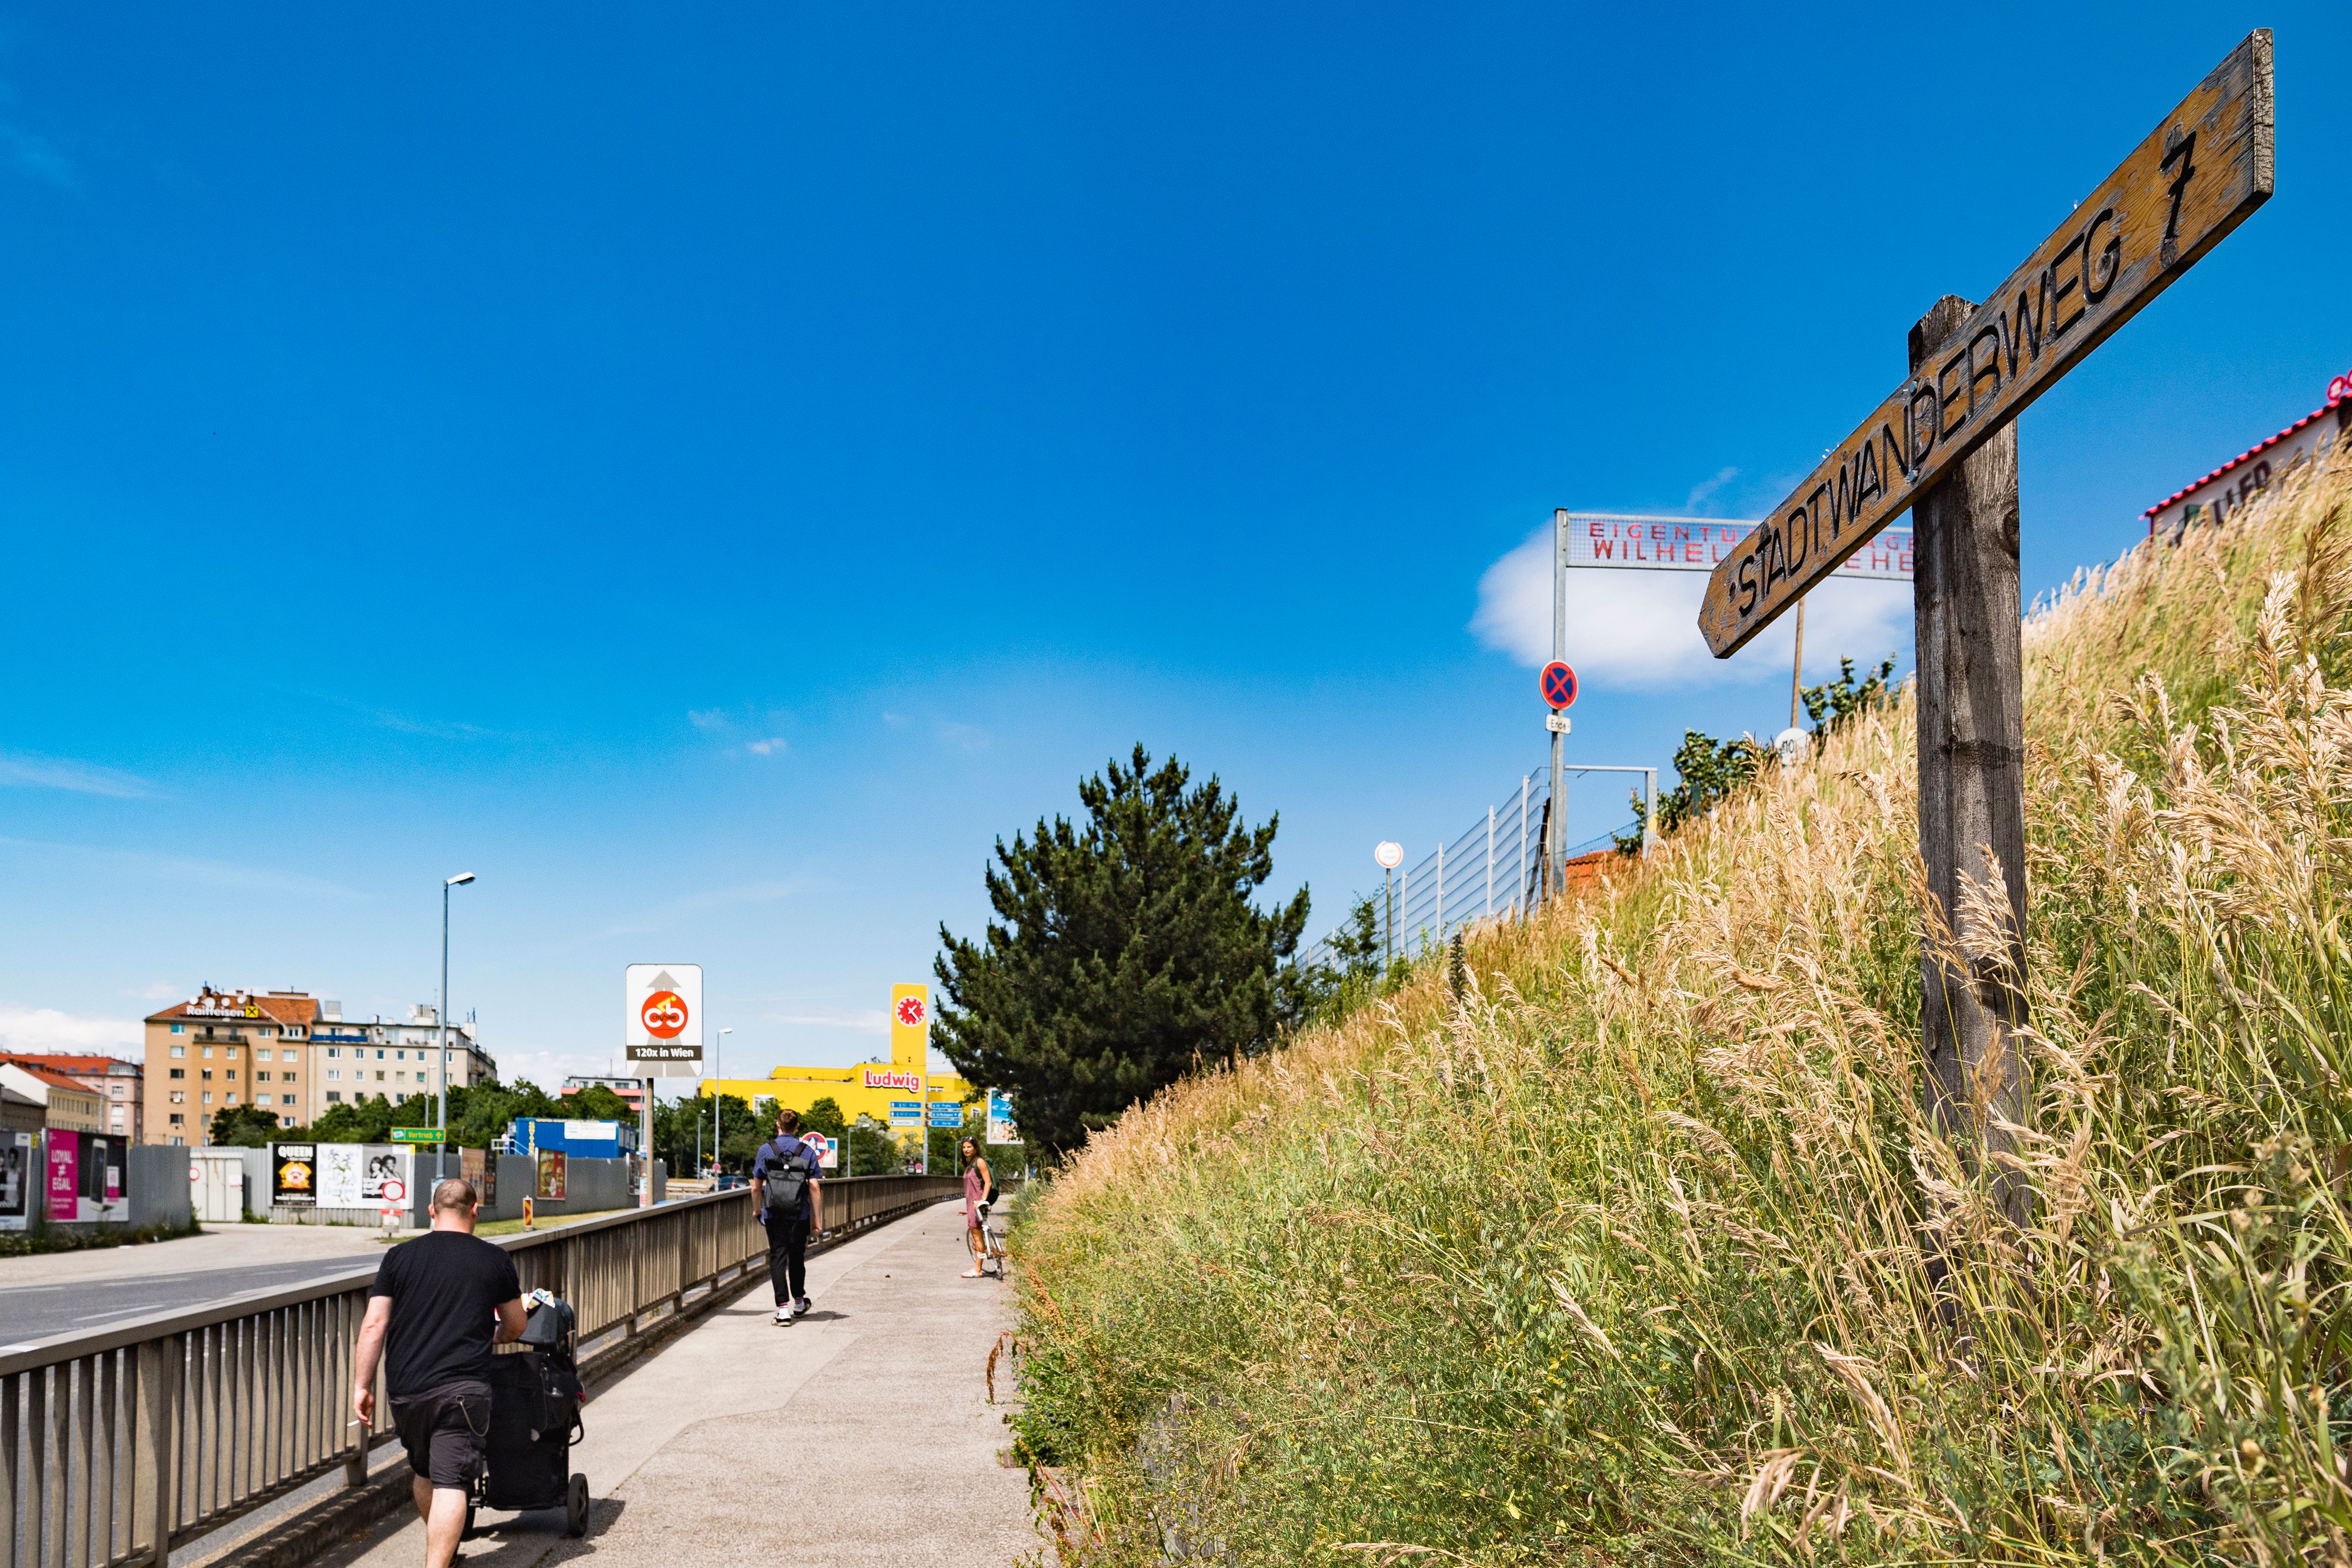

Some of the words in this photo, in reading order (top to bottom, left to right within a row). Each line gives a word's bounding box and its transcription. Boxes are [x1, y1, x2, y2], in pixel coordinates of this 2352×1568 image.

[1739, 208, 2120, 617] STADTWANDERWEG
[2160, 131, 2196, 244] 7
[1593, 540, 1739, 563] WILHEL
[186, 1004, 245, 1017] Raiffeisen
[636, 1048, 657, 1057] 120x
[660, 1048, 669, 1057] in
[670, 1048, 694, 1057] Wien
[865, 1069, 920, 1092] Ludwig
[278, 1145, 313, 1158] QUEEN
